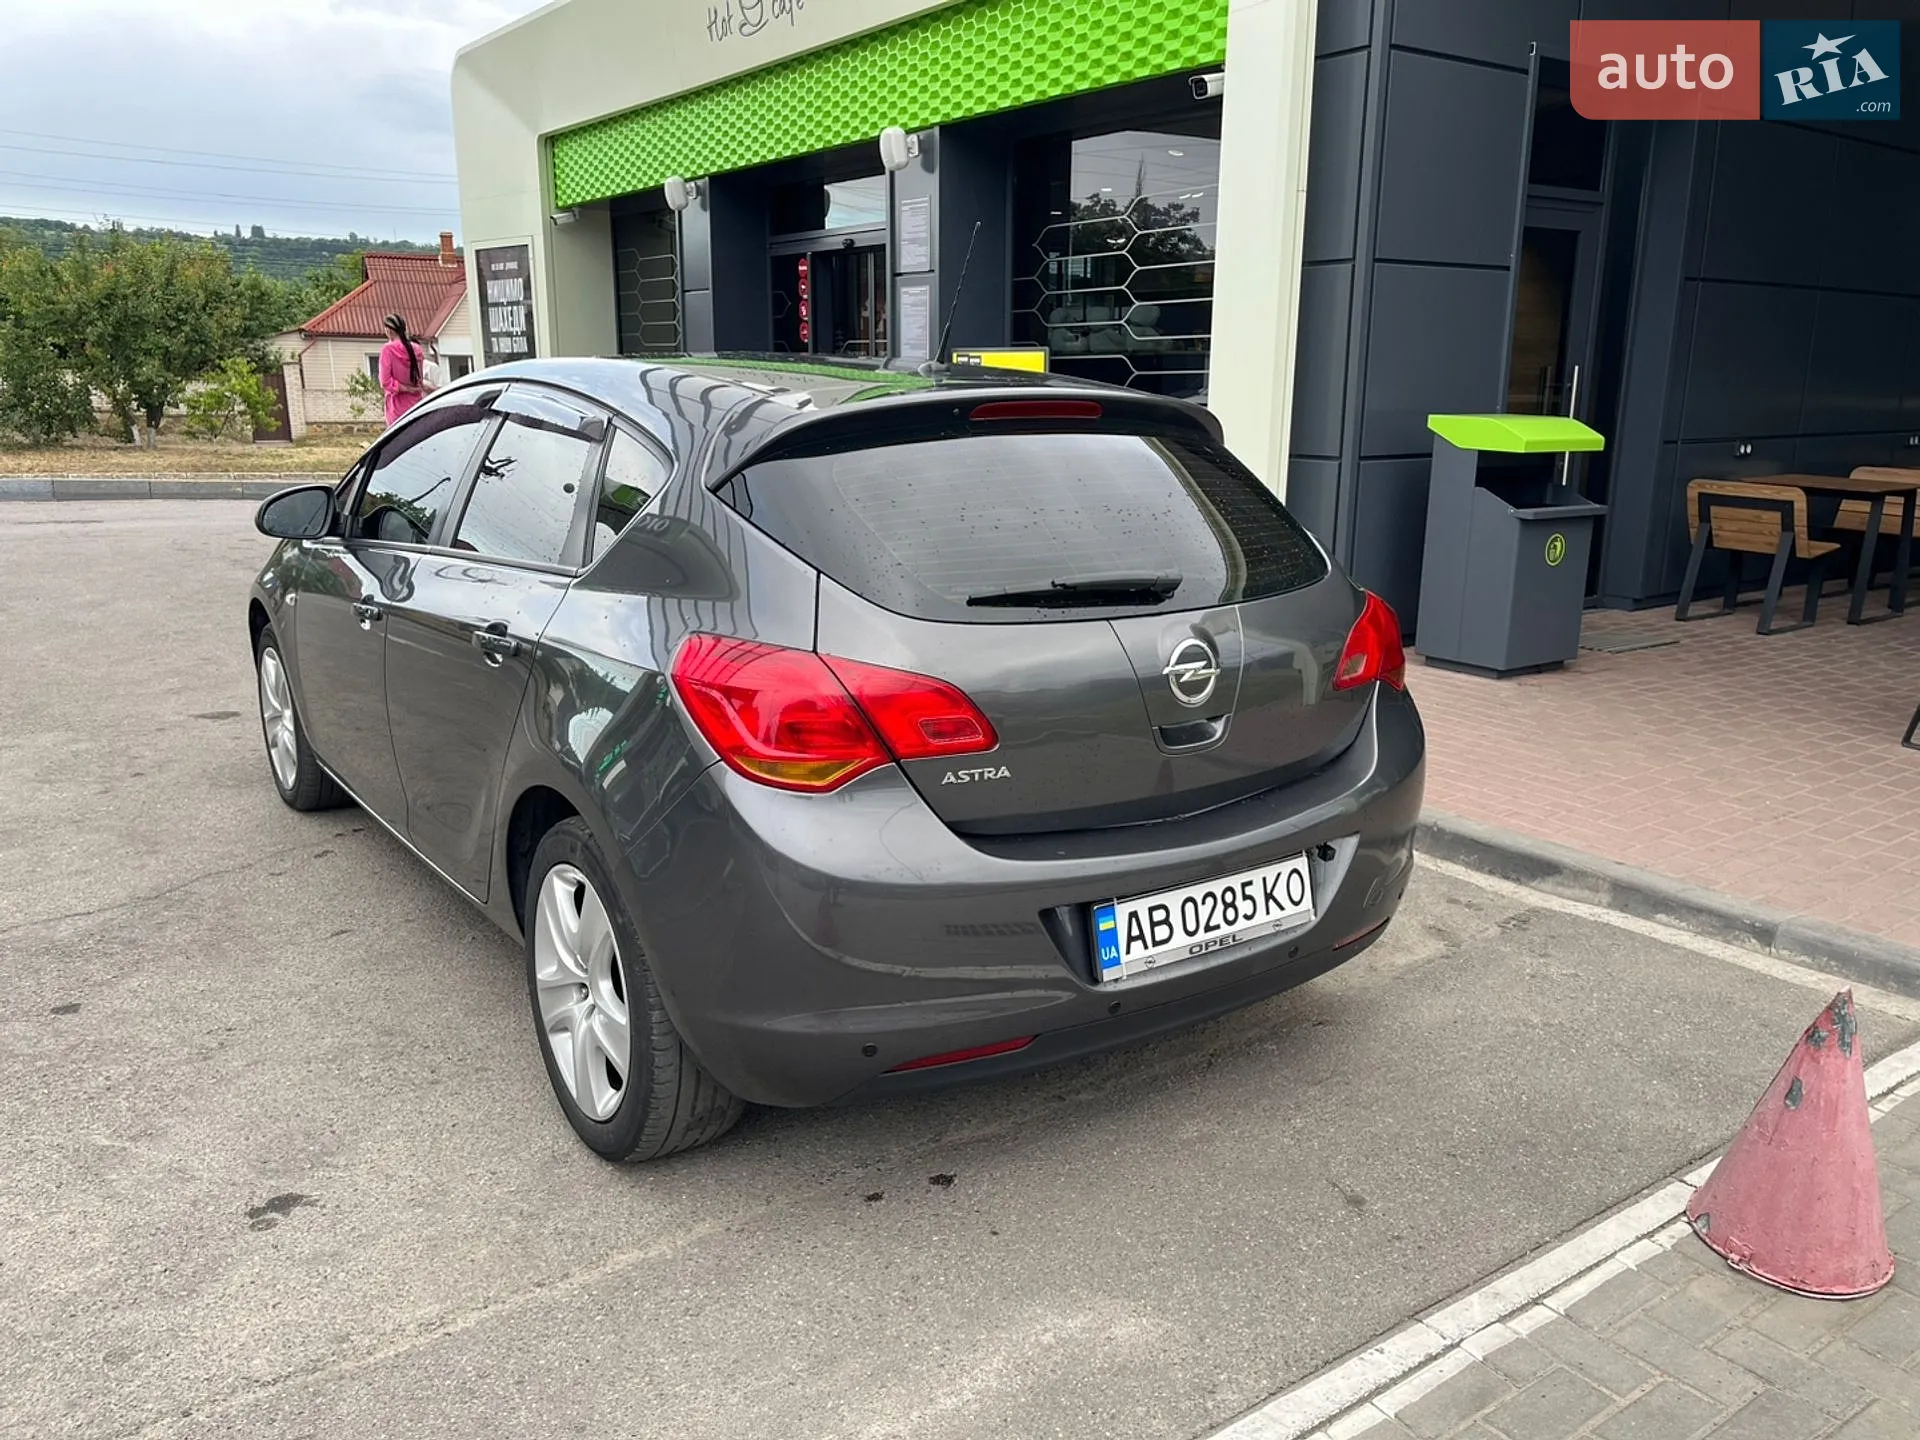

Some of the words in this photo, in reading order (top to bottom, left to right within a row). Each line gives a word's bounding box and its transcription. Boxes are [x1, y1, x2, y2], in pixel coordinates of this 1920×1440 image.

[707, 0, 733, 41] Hot
[941, 766, 1011, 785] ASTRA
[1125, 903, 1174, 956] AB
[1180, 880, 1257, 938] 0285
[1262, 867, 1305, 916] KO
[1101, 947, 1118, 961] UA
[1188, 934, 1243, 955] OPEL
